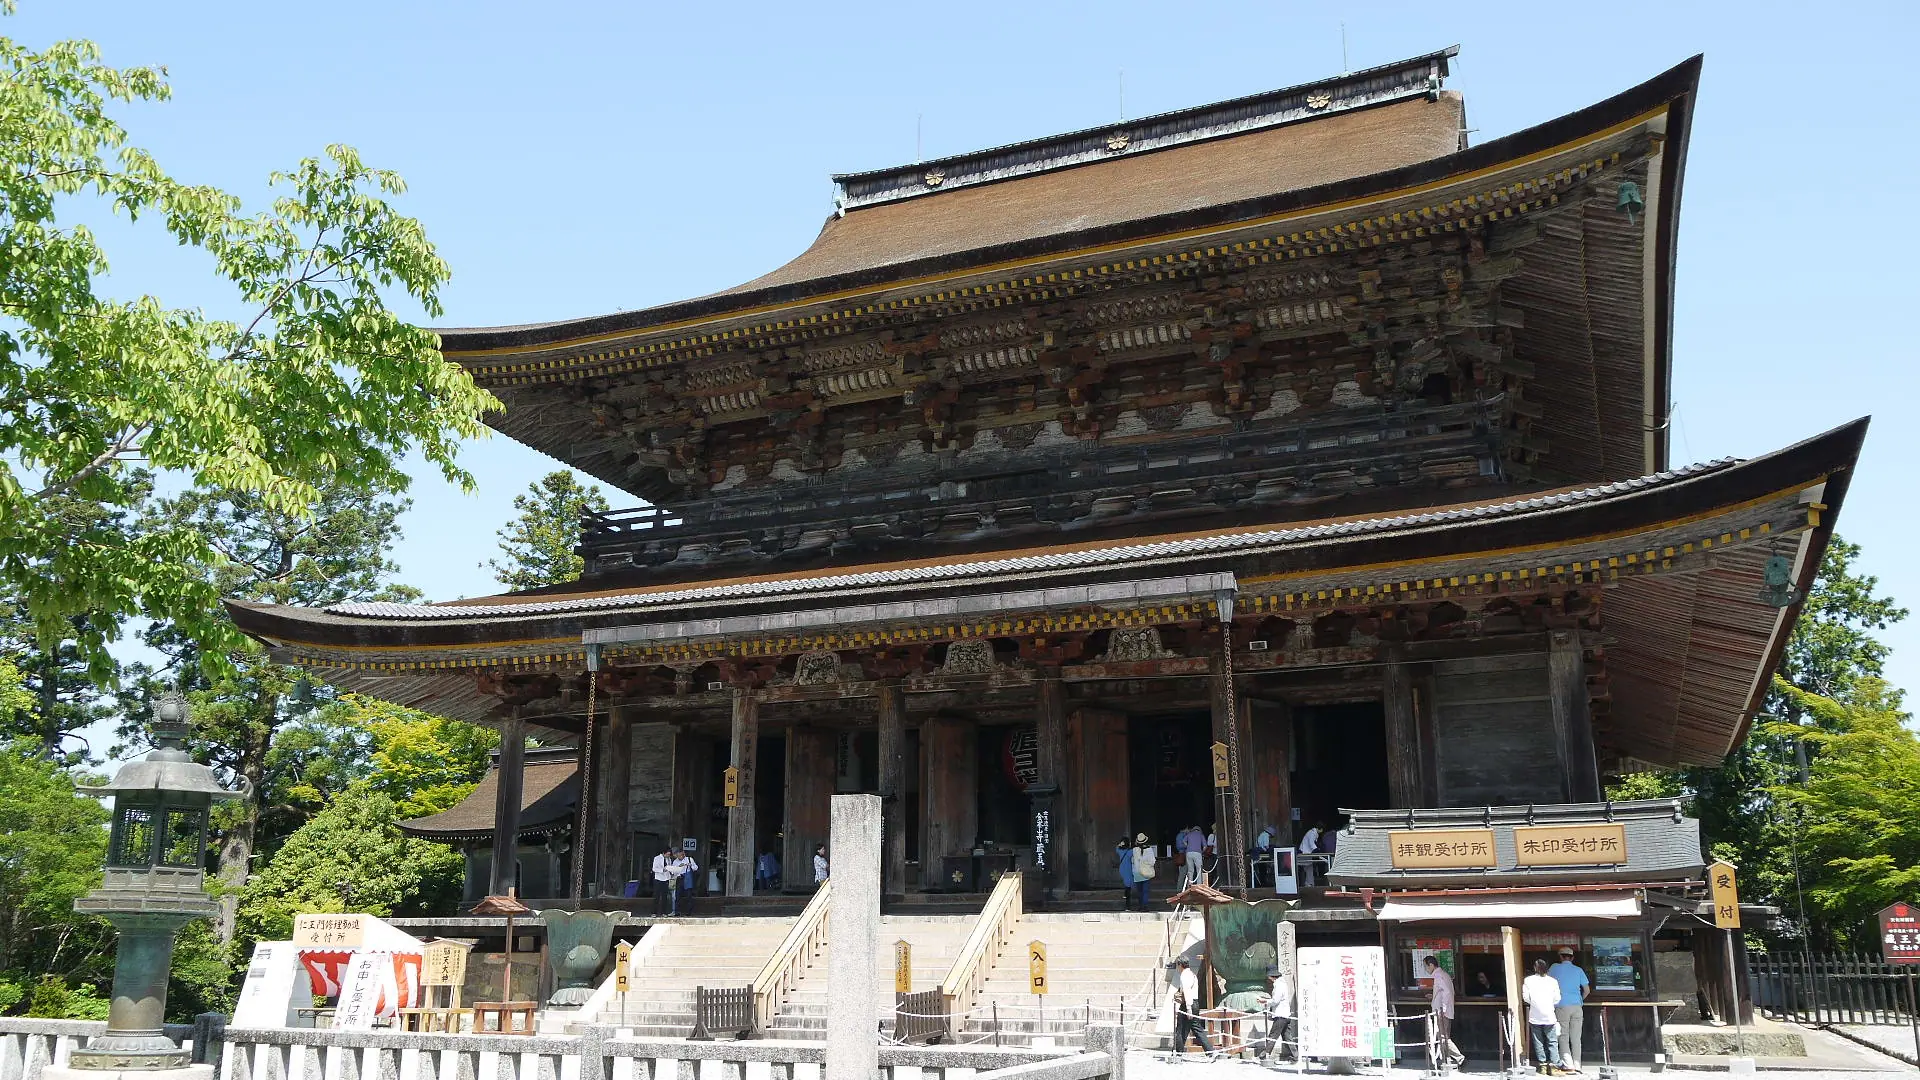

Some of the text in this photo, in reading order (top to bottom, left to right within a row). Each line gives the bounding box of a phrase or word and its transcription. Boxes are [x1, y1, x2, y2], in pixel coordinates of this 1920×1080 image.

[1215, 753, 1226, 780] 入口
[727, 776, 735, 800] 出口
[1398, 842, 1488, 857] 拝観受付所
[1523, 837, 1618, 855] 朱印受付所
[1717, 874, 1733, 919] 受付
[310, 932, 346, 943] 受付所
[619, 952, 628, 984] 出口
[1033, 951, 1044, 987] 入口
[1341, 955, 1357, 1049] ご本尊特別ご開帳
